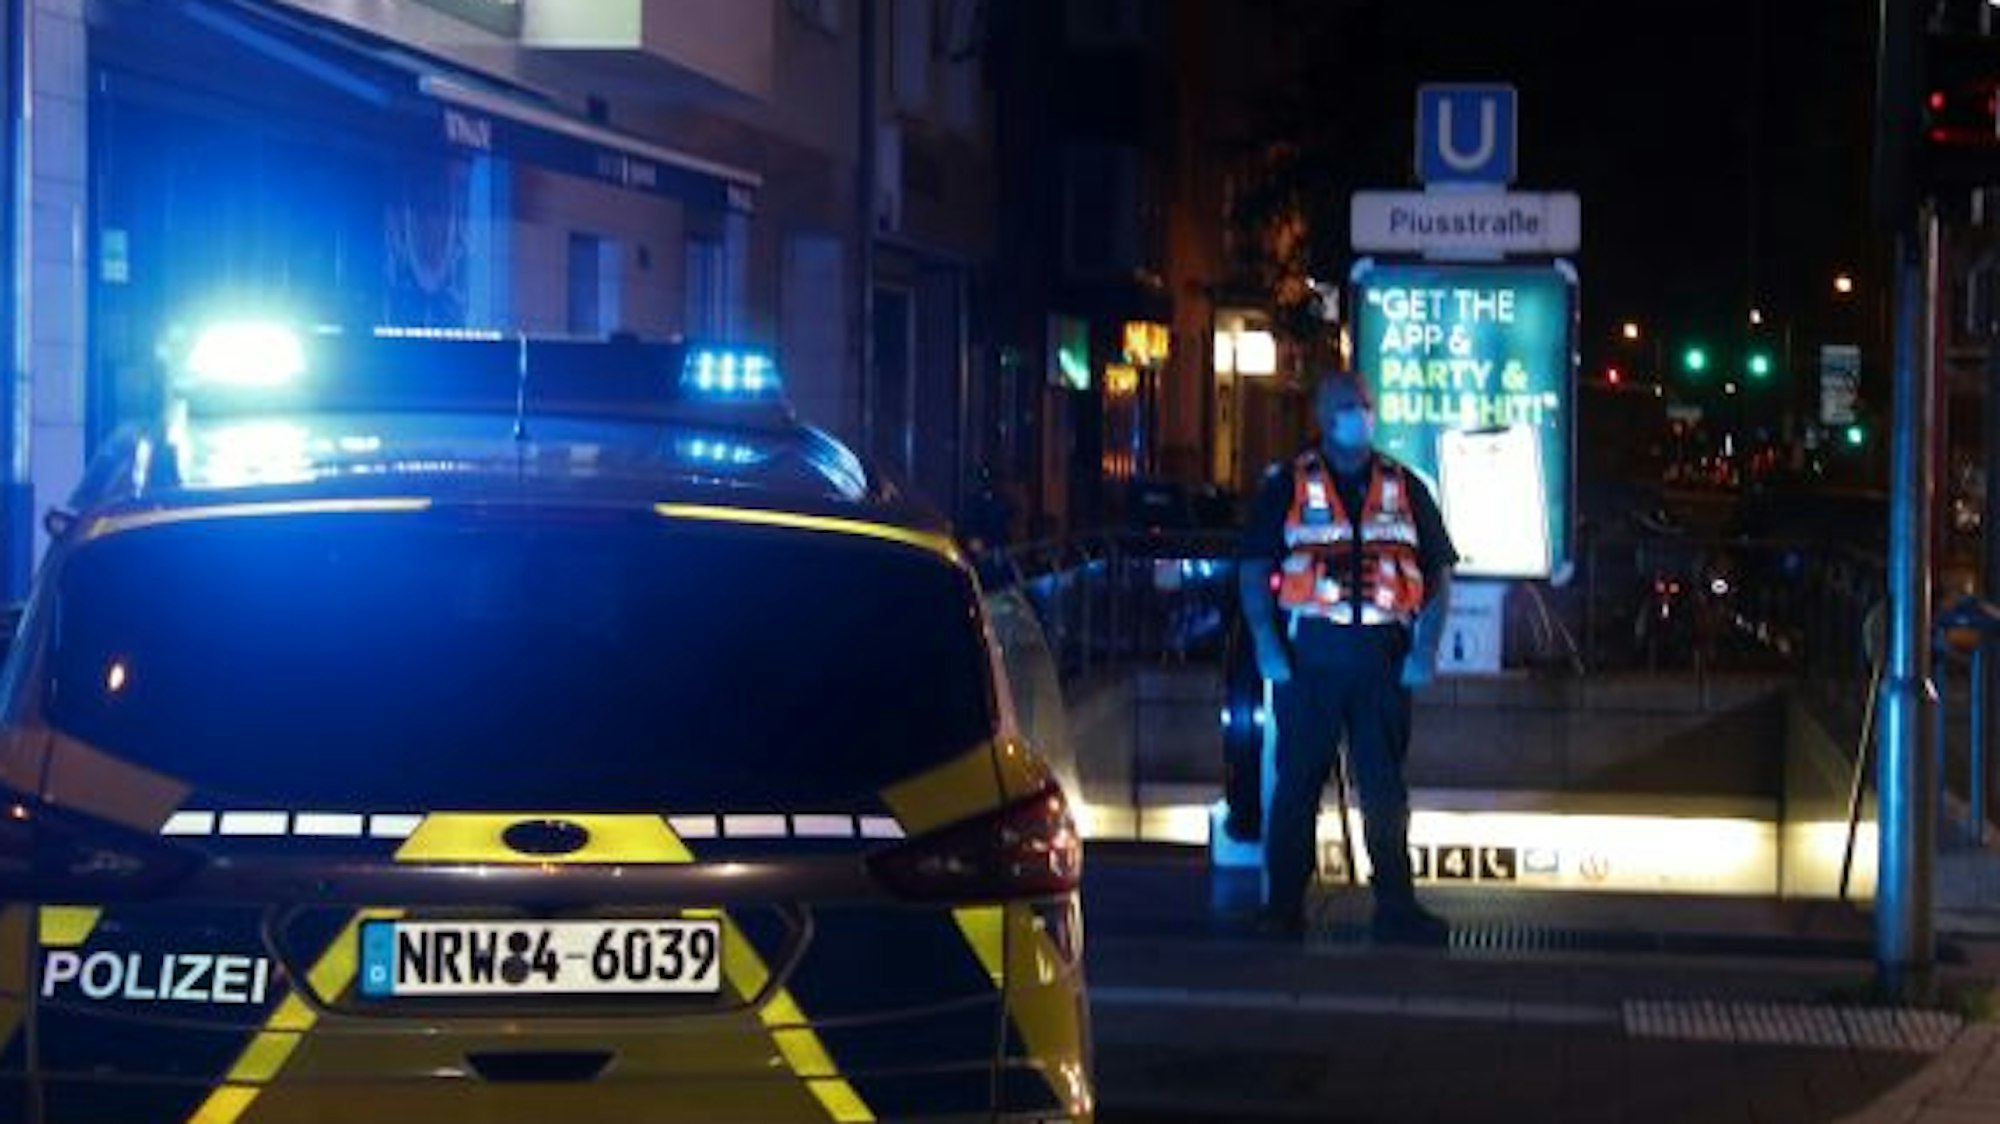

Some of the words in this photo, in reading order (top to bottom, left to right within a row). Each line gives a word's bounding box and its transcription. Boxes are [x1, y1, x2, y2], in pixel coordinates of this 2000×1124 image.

[1437, 97, 1496, 171] U
[1389, 208, 1540, 238] Piusstraße
[1452, 290, 1515, 322] THE
[1381, 324, 1443, 354] APP
[1448, 325, 1472, 355] &
[1381, 359, 1492, 390] PARTY
[1501, 361, 1528, 390] &
[1444, 848, 1466, 875] 4
[398, 931, 497, 984] NRW
[532, 929, 716, 983] 4-6039
[41, 951, 269, 1004] POLIZEI
